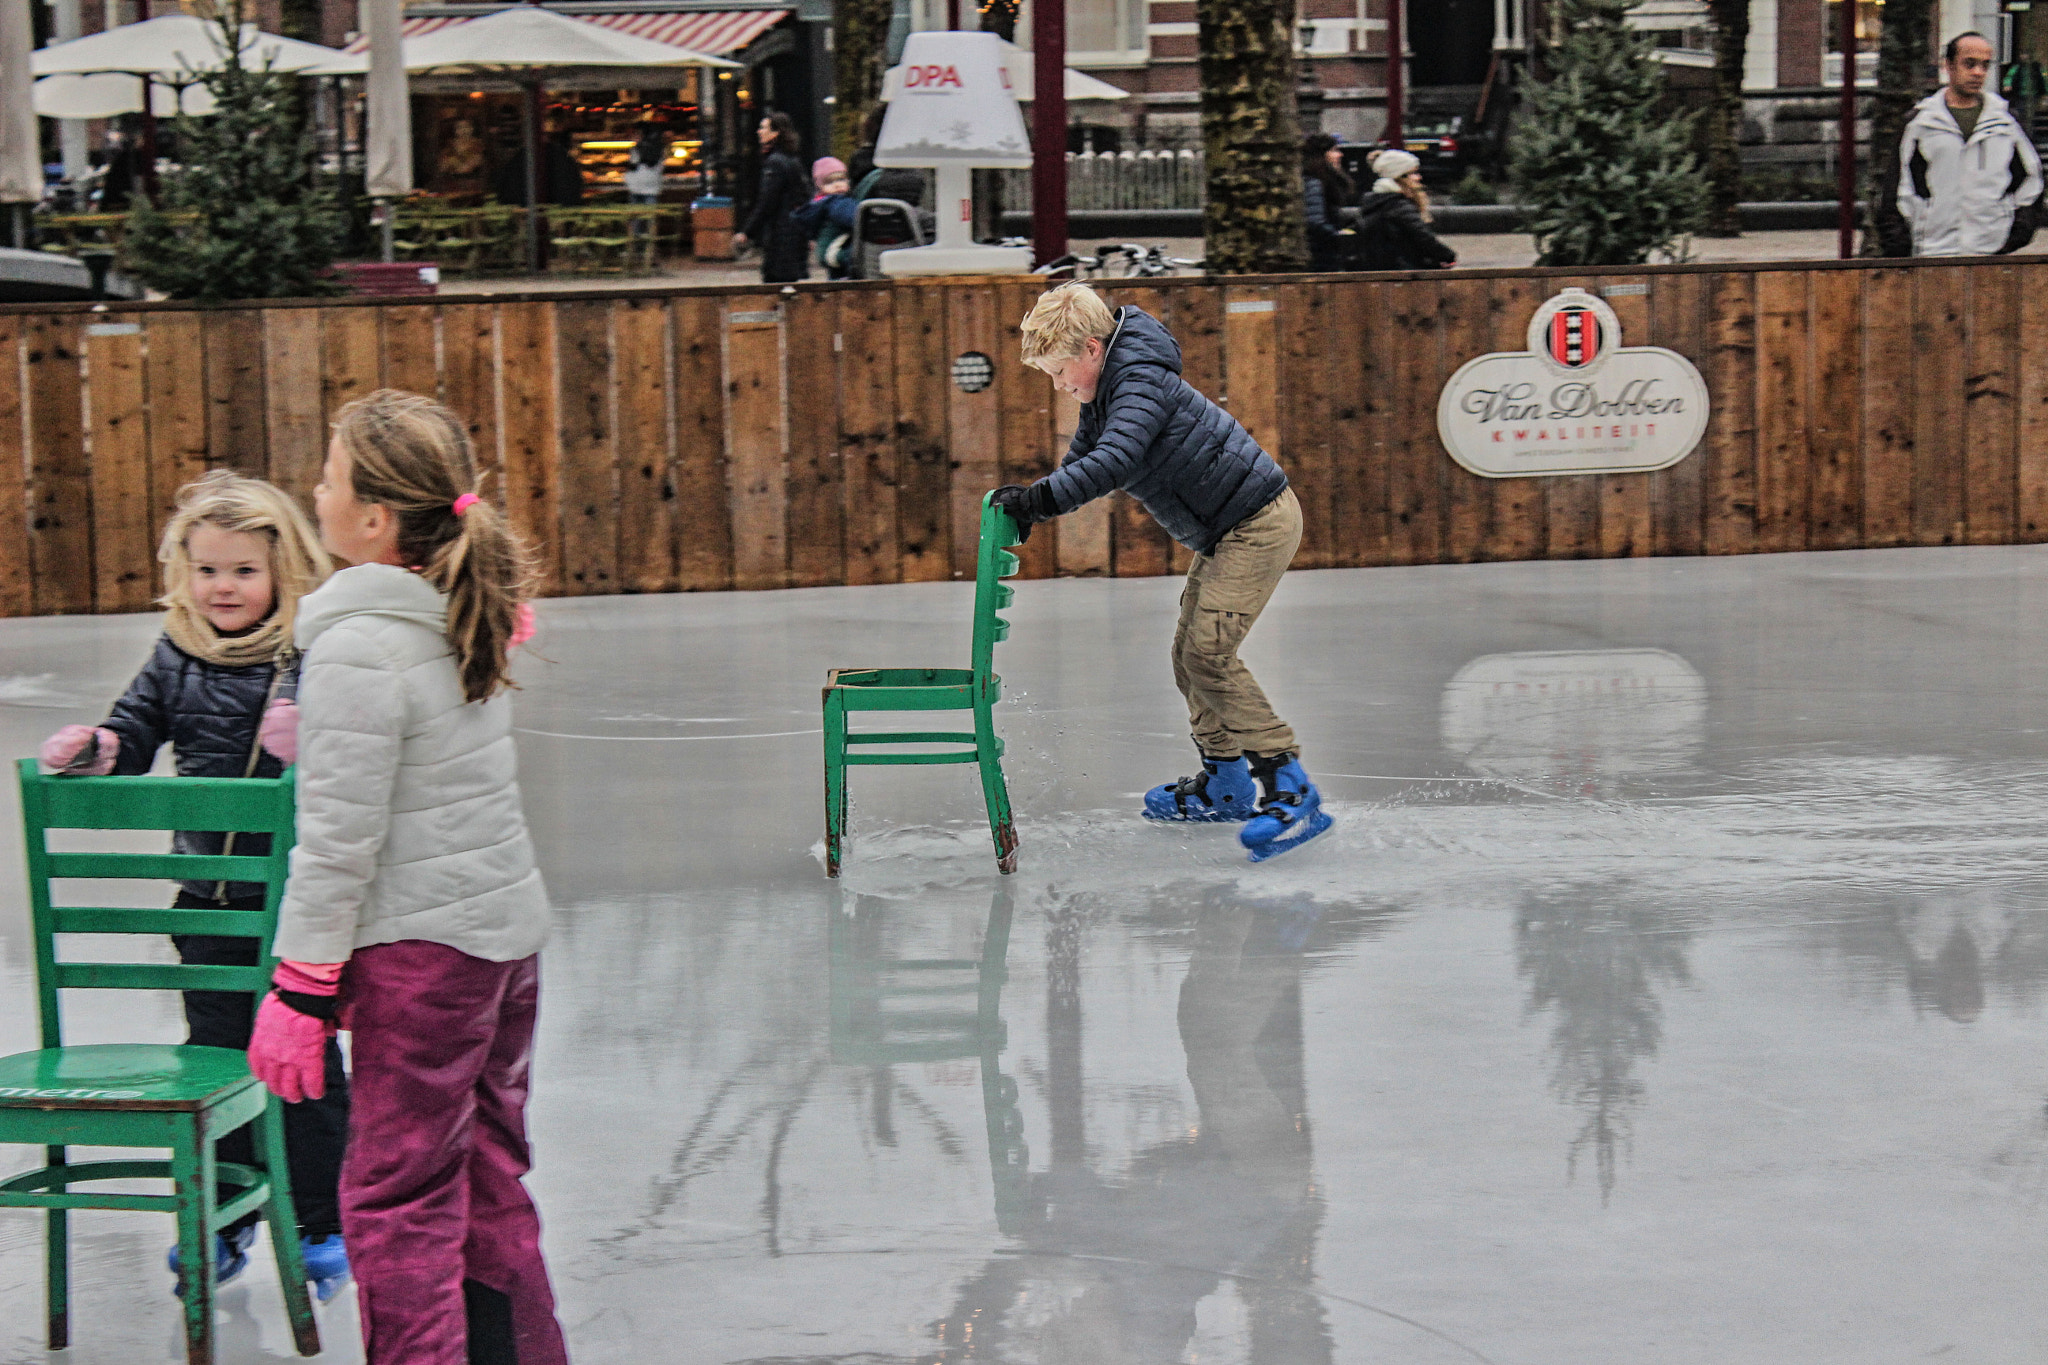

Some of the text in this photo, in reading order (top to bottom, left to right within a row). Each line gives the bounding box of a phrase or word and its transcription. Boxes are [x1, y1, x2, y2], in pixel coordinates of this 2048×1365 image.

[904, 64, 963, 88] DPA
[1461, 379, 1686, 423] Van Dobben
[1491, 424, 1657, 442] KWALITEIT
